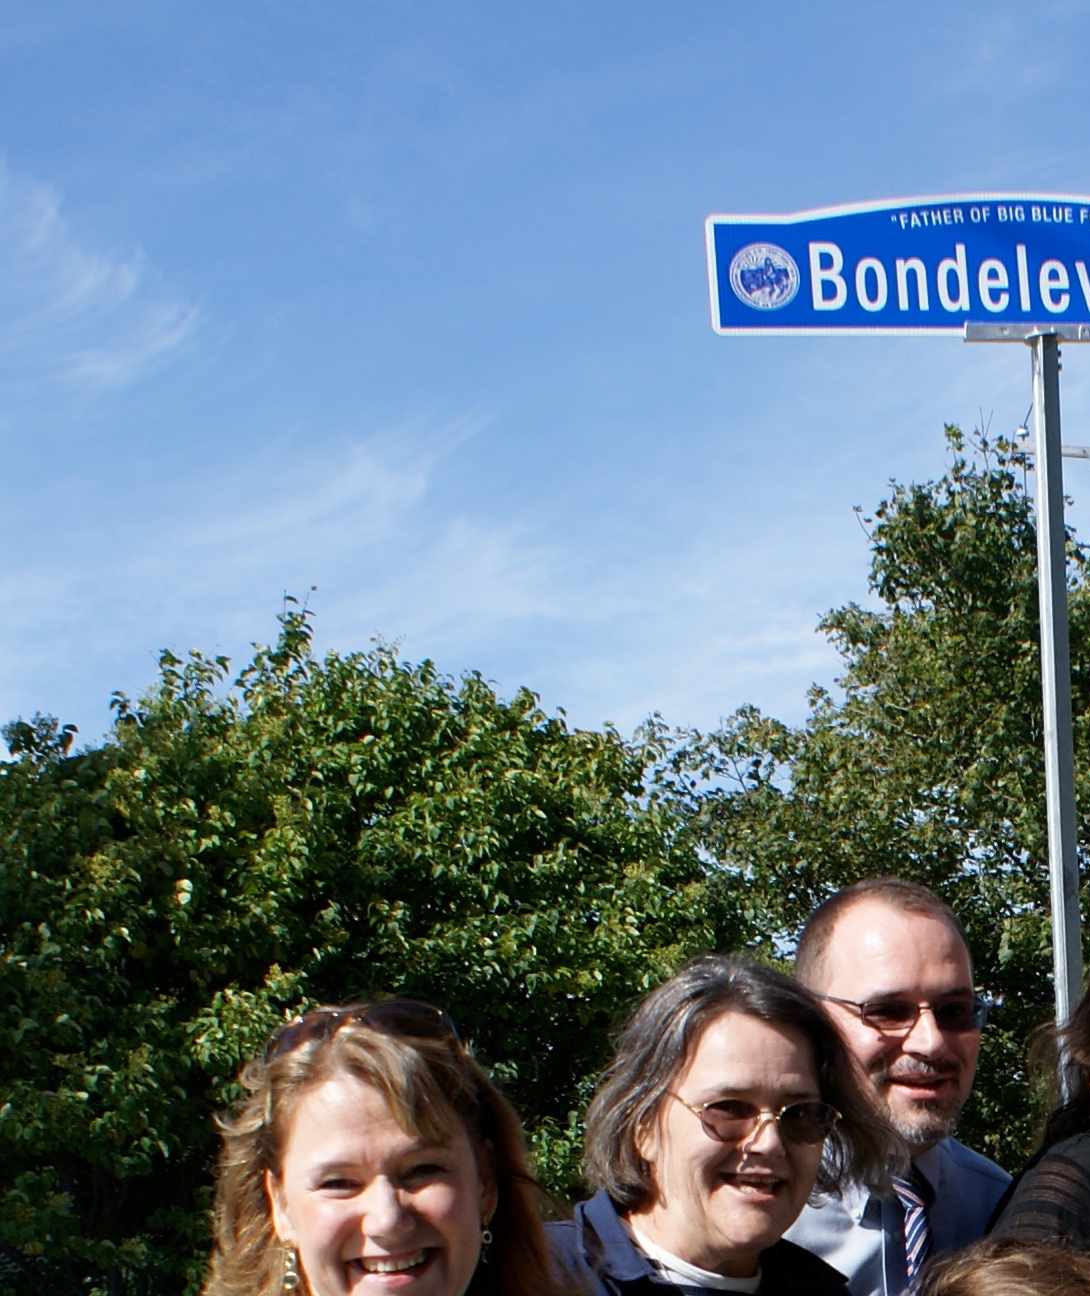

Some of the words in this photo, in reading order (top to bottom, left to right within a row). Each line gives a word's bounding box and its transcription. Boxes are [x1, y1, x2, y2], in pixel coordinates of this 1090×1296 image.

[891, 208, 964, 230] "FATHER
[970, 207, 990, 222] OF
[998, 205, 1025, 221] BIG
[1032, 205, 1073, 223] BLUE
